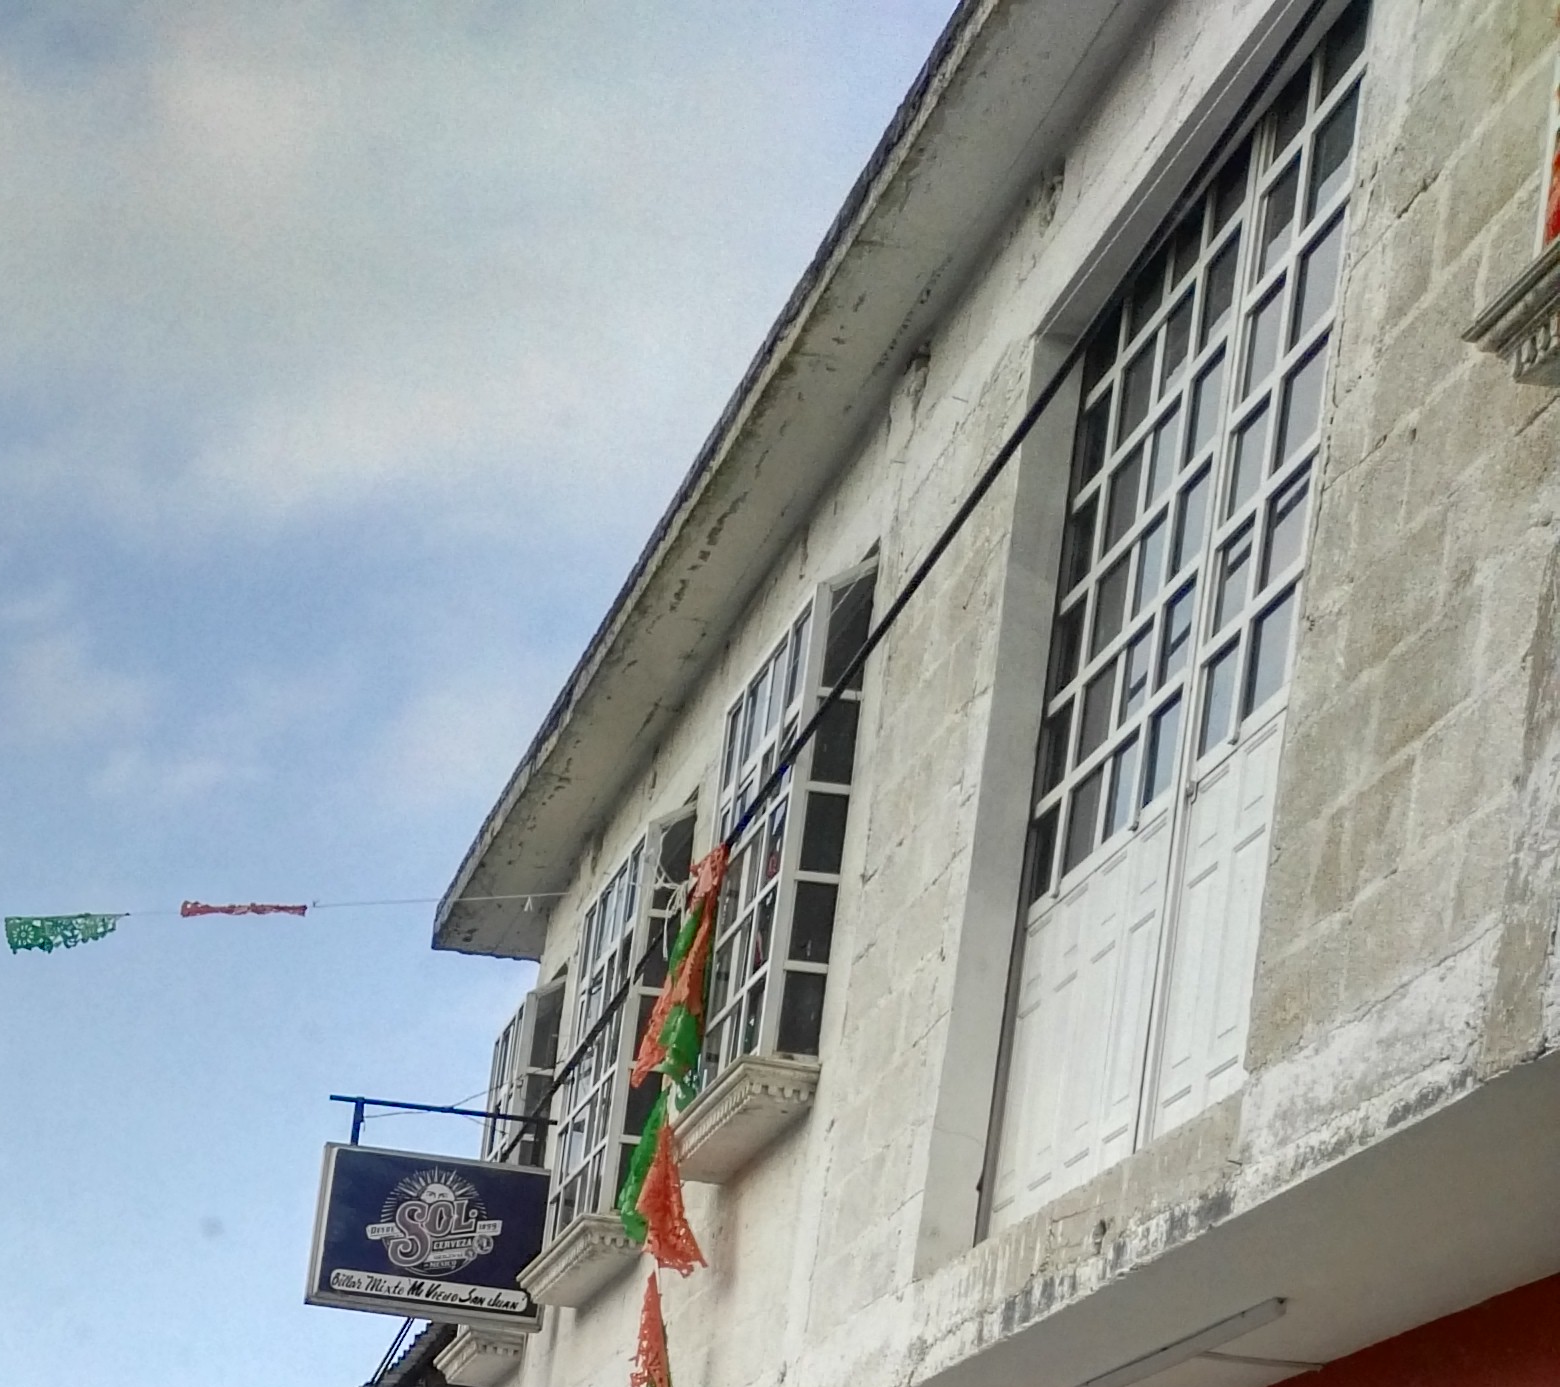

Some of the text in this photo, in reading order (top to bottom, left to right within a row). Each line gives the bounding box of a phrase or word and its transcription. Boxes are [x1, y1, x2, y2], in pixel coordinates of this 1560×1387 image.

[388, 1199, 476, 1267] SOL
[433, 1238, 472, 1250] CERVEZA
[331, 1272, 362, 1290] Billar
[365, 1275, 404, 1296] Mixto
